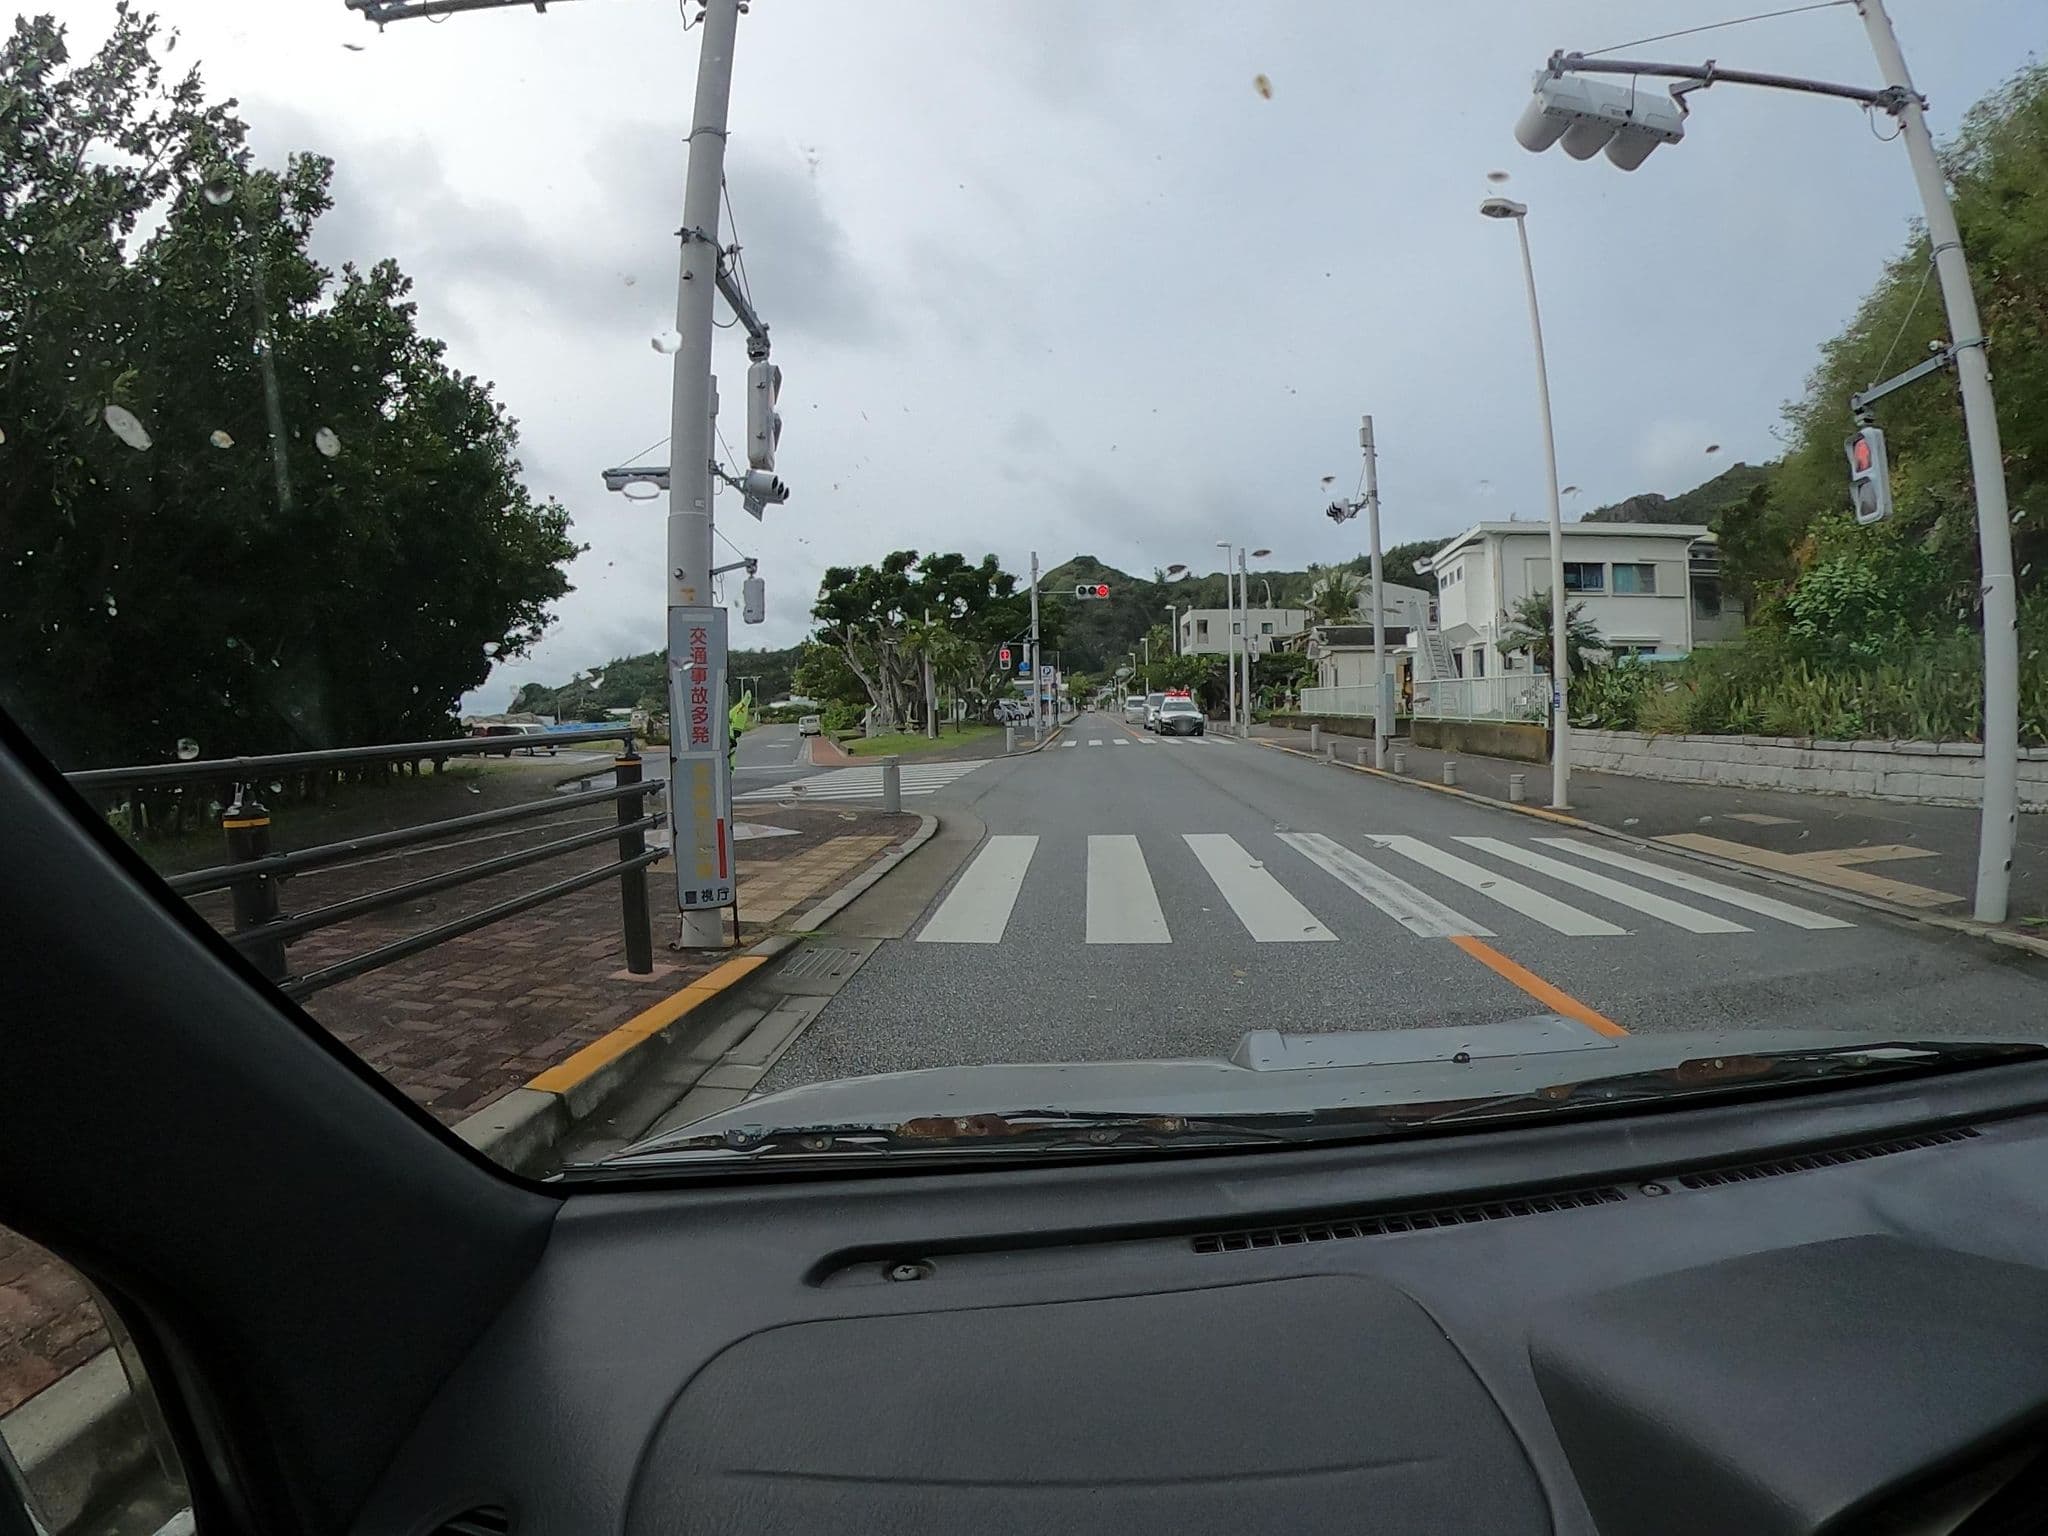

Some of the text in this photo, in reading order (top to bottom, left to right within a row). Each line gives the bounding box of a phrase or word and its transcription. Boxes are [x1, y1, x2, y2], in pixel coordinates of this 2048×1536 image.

[689, 626, 710, 745] 交通事故多発
[684, 887, 730, 905] 視庁
